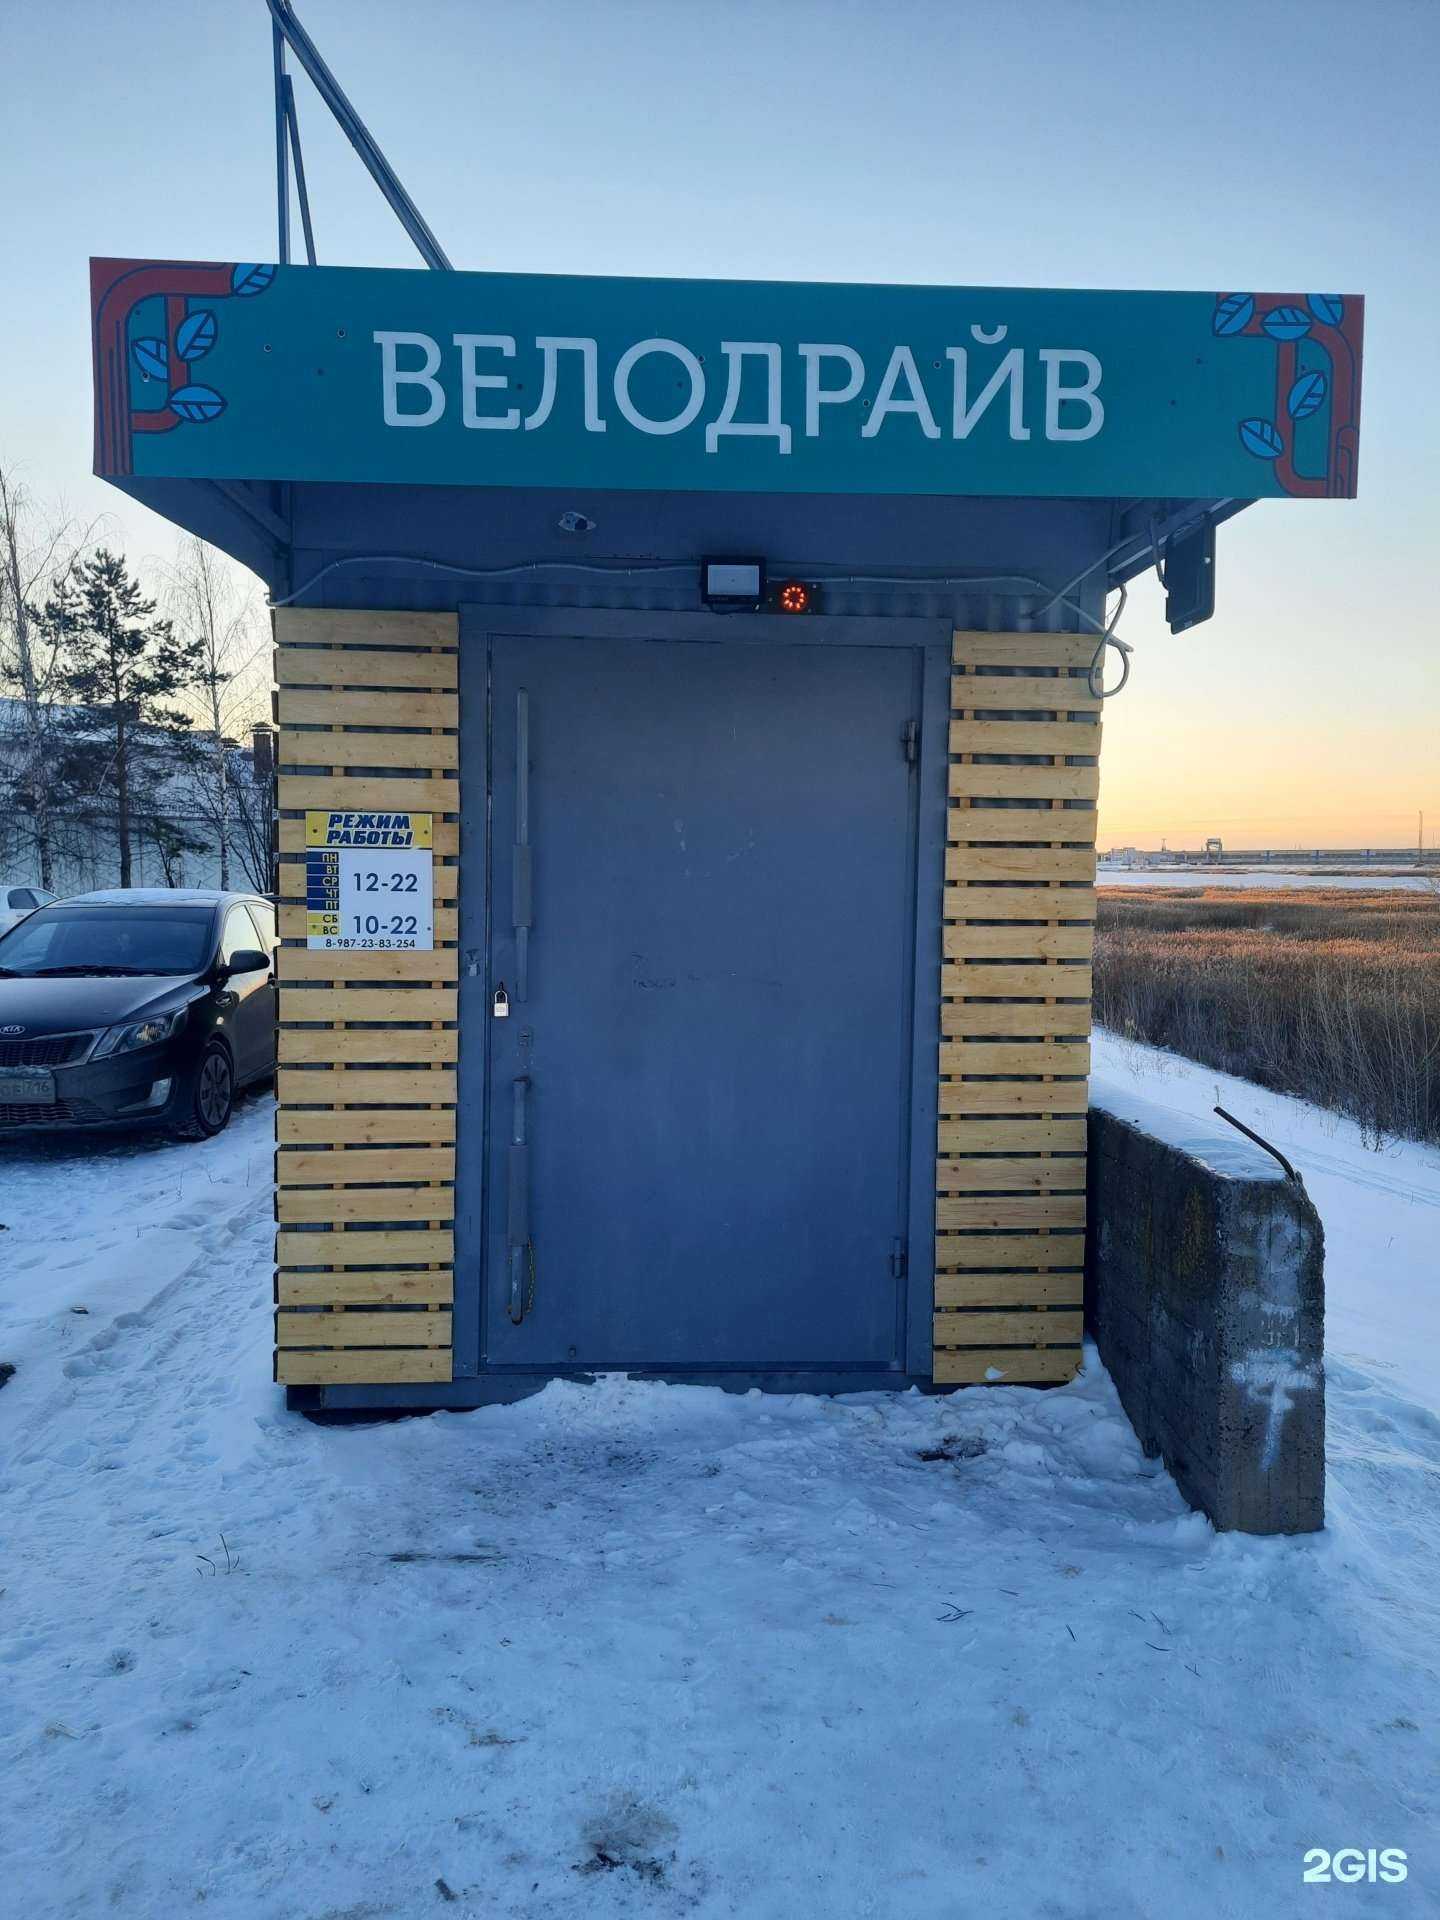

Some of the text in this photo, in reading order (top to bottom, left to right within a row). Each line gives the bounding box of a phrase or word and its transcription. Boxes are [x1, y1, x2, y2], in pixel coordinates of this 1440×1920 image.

[373, 325, 1105, 454] ВЕЛОДРАЙВ
[328, 814, 411, 829] РЕЖИМ
[326, 830, 414, 845] РАБОТЫ
[322, 853, 337, 862] ПН
[326, 865, 337, 874] ВТ
[322, 877, 337, 886] СР
[353, 872, 418, 892] 12-22
[326, 889, 337, 898] ЧТ
[325, 901, 337, 910] ПТ
[322, 914, 338, 923] СБ
[353, 915, 418, 935] 10-22
[322, 926, 338, 935] ВС
[325, 939, 415, 948] 8-987-23-83-254
